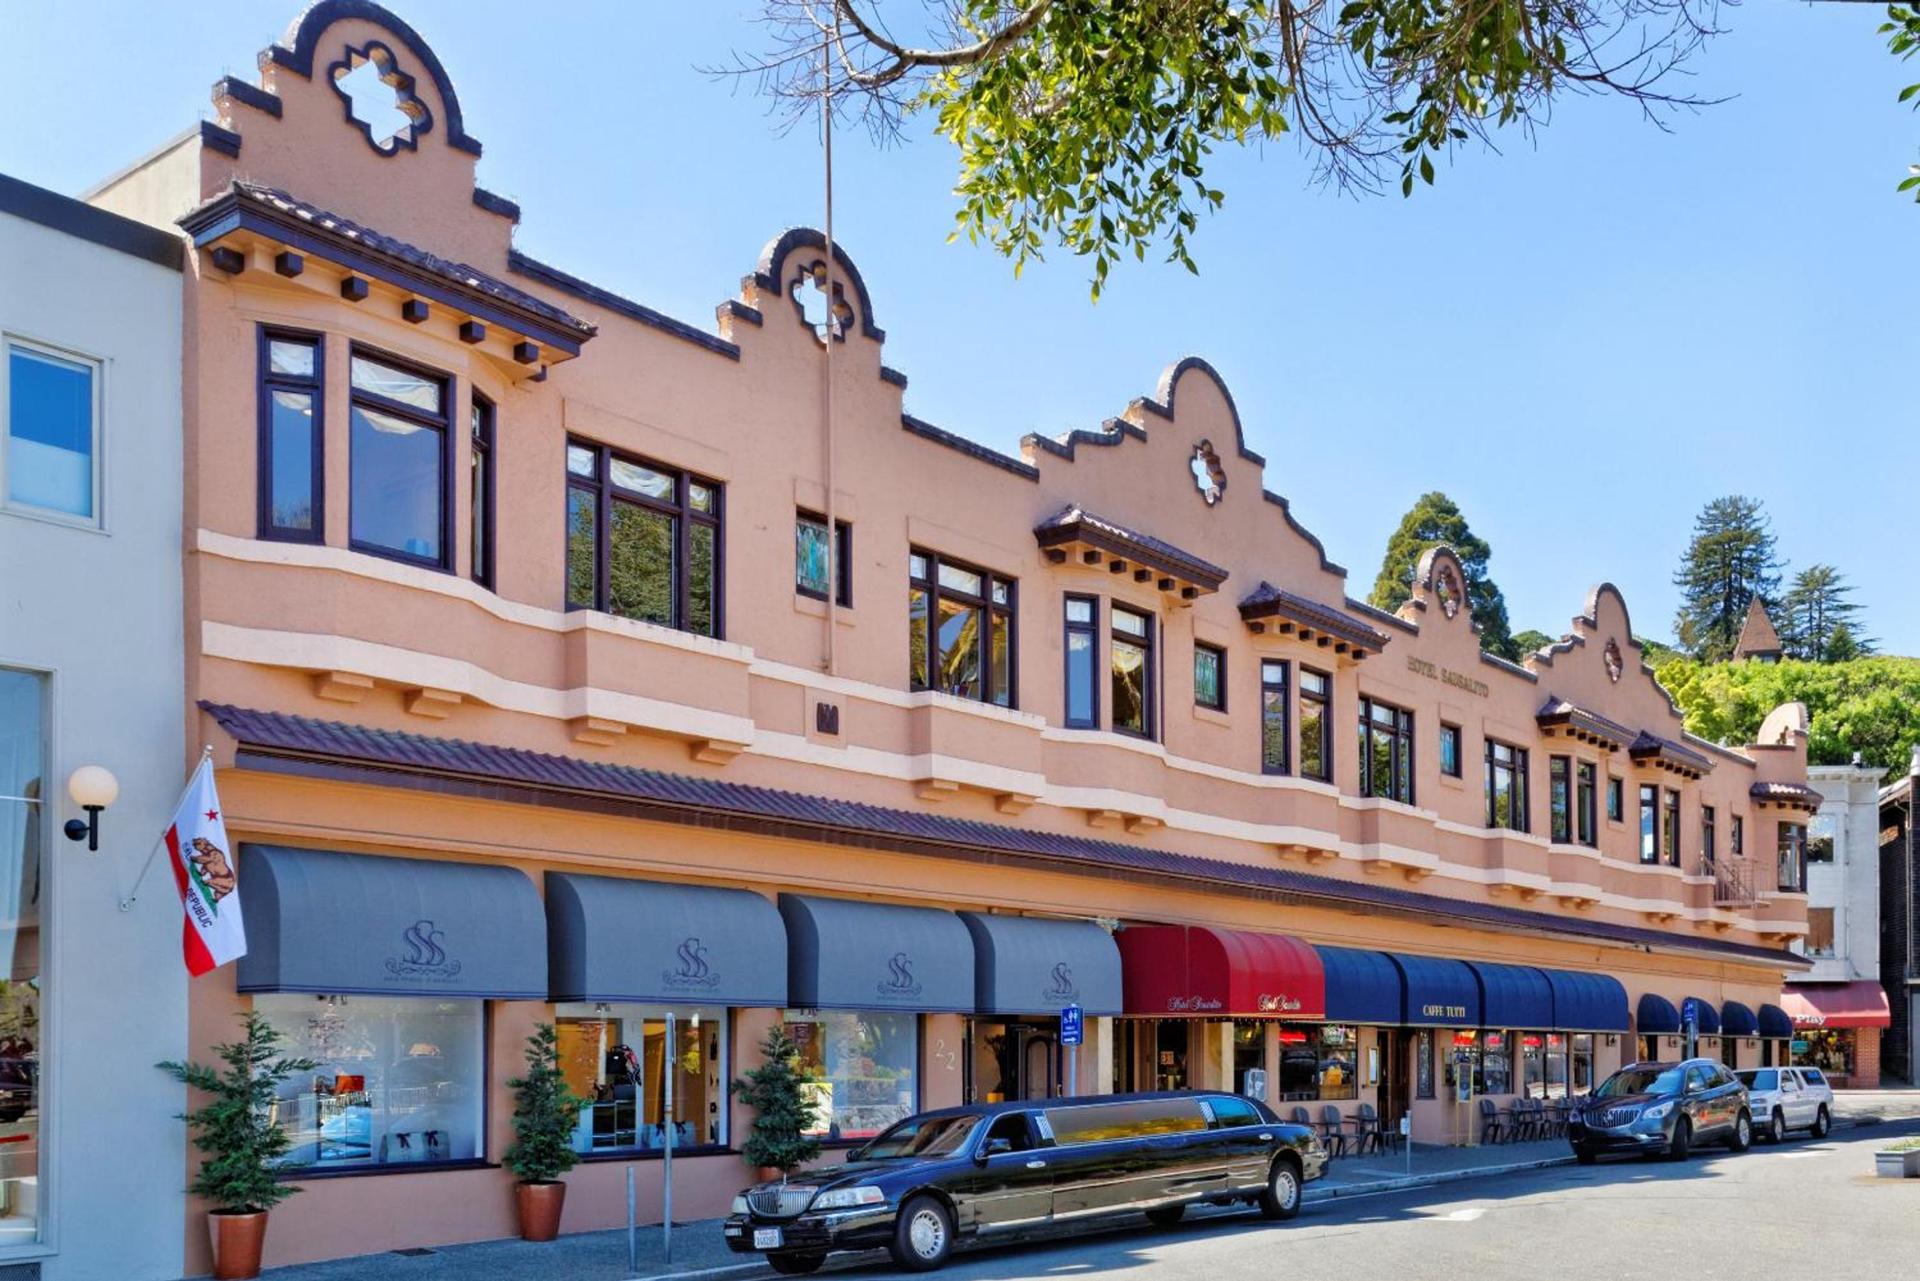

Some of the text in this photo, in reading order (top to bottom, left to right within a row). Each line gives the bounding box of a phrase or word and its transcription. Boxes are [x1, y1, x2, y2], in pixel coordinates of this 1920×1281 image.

[1407, 655, 1438, 680] HOTEL
[187, 888, 213, 928] REPUBLIC
[1422, 1004, 1444, 1016] CAFFE
